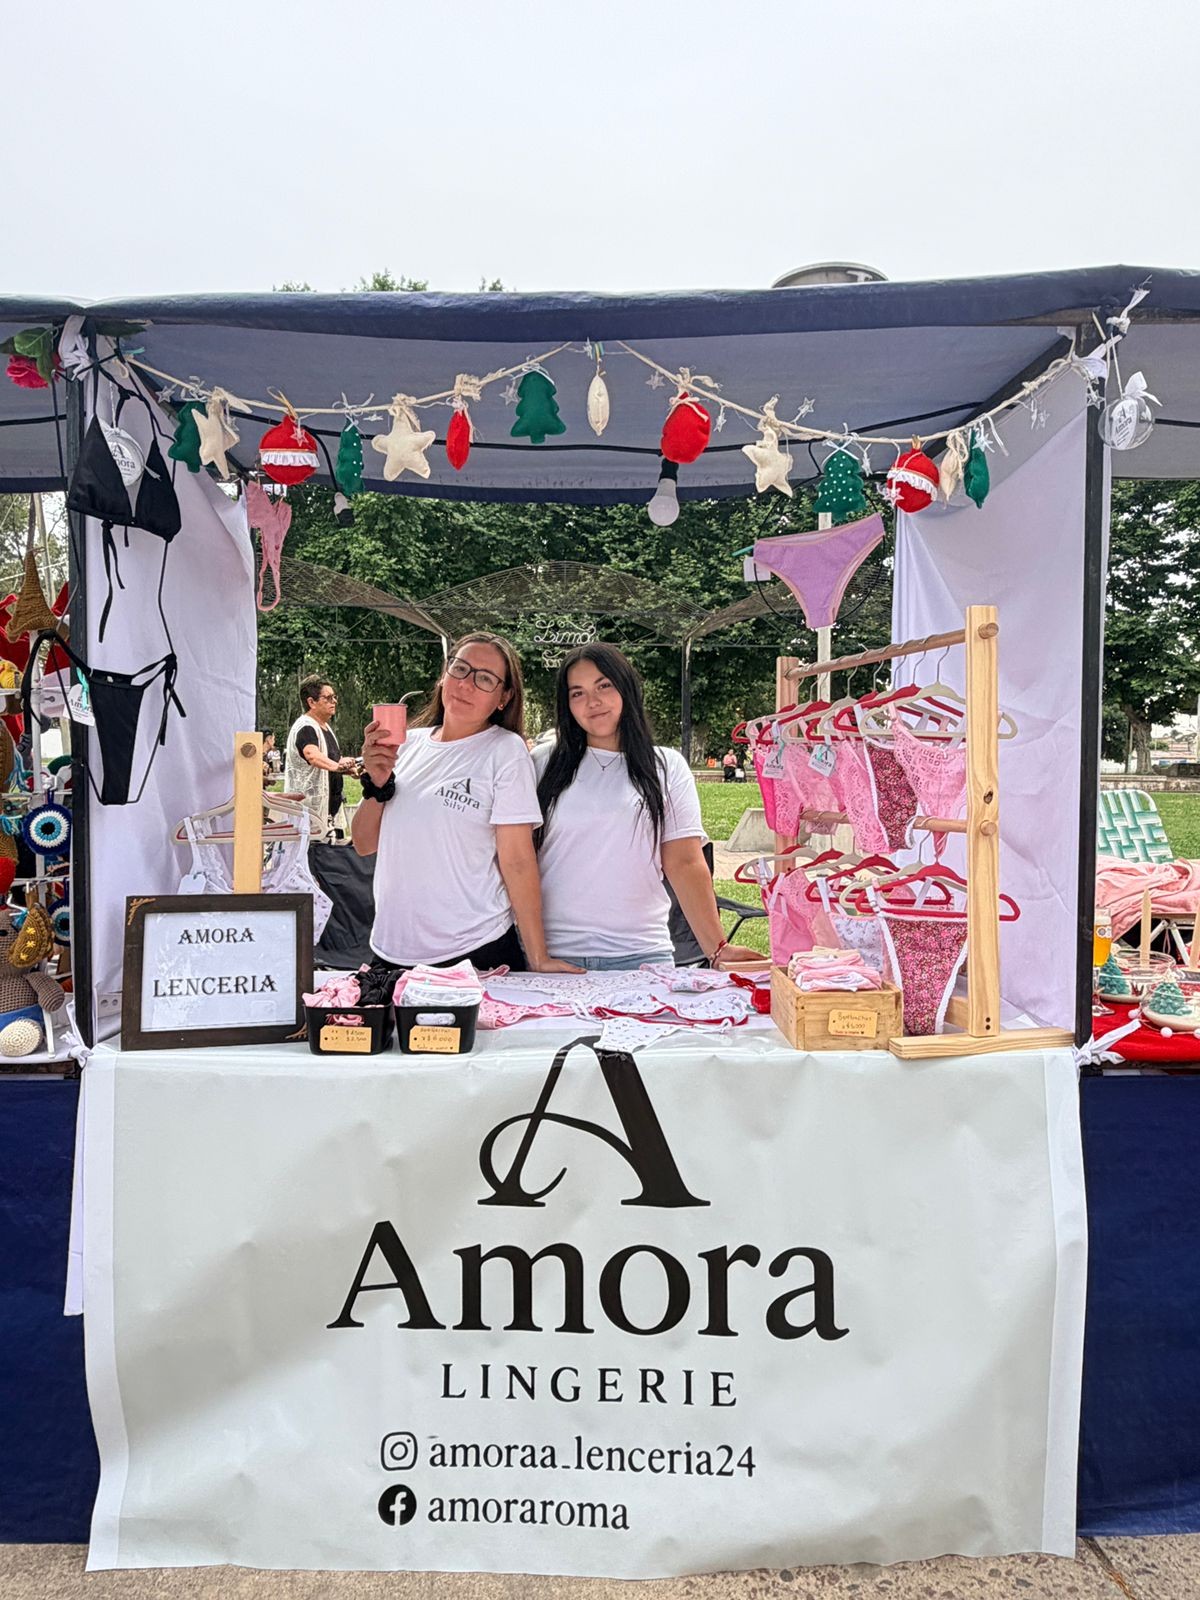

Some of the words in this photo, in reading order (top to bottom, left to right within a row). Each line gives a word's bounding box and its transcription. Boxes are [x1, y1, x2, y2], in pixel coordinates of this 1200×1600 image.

[434, 786, 480, 809] Amora
[177, 927, 255, 945] AMORA
[153, 974, 278, 998] LENCERIA
[327, 1220, 850, 1341] Amora
[441, 1363, 738, 1407] LINGERIE
[428, 1436, 756, 1477] amoraa_lenceria24
[427, 1497, 631, 1530] amoraroma
